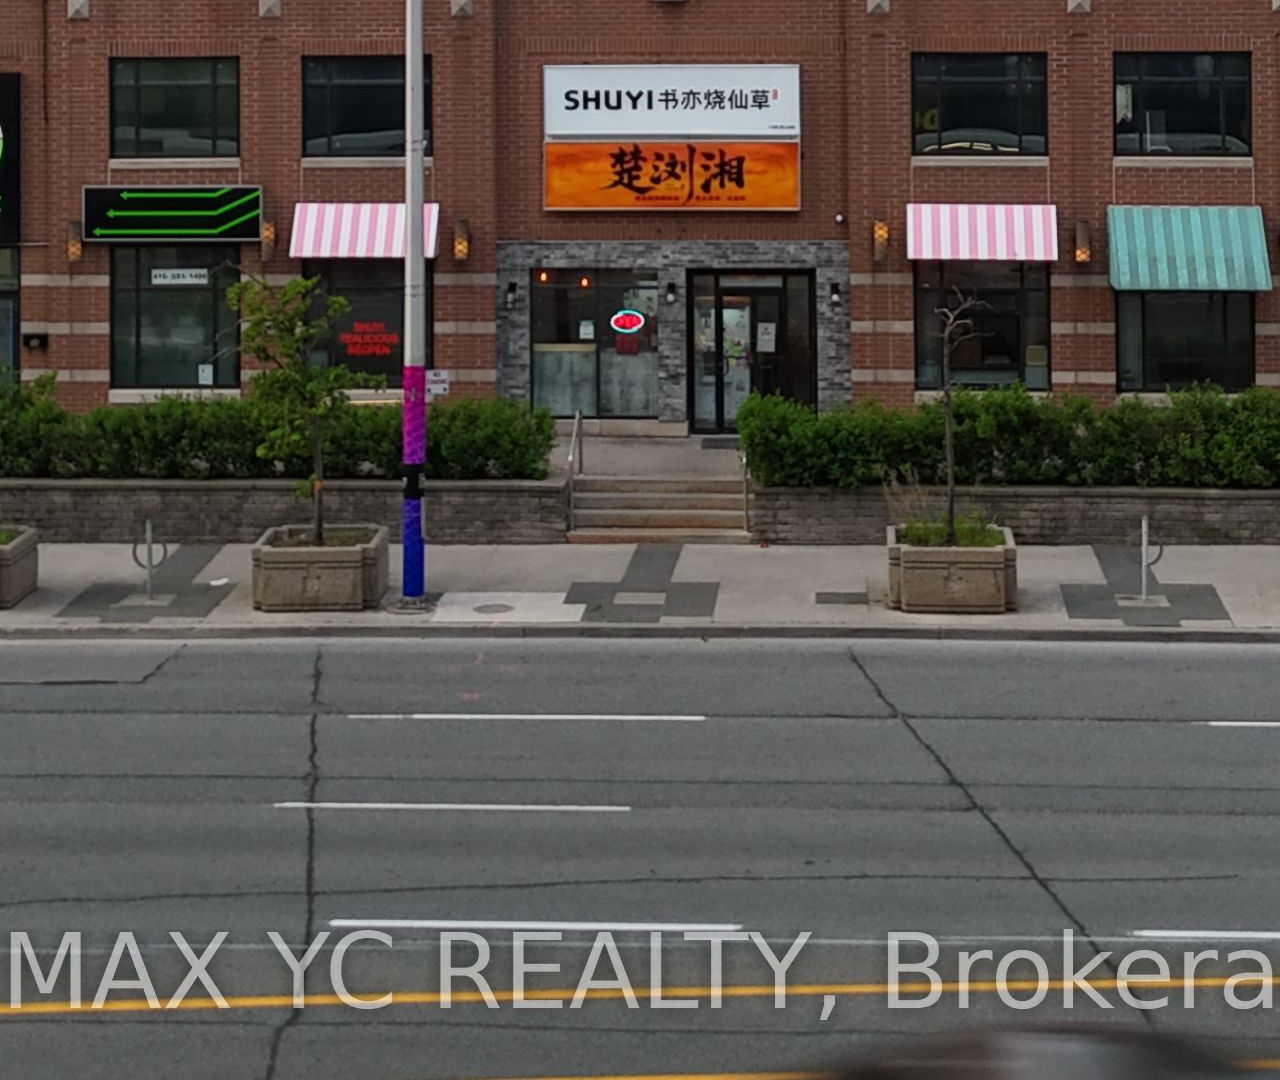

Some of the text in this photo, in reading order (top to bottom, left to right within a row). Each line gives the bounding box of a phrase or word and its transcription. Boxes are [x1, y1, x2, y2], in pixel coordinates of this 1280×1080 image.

[564, 90, 653, 110] SHUYI
[658, 89, 771, 111] 书亦烧仙草
